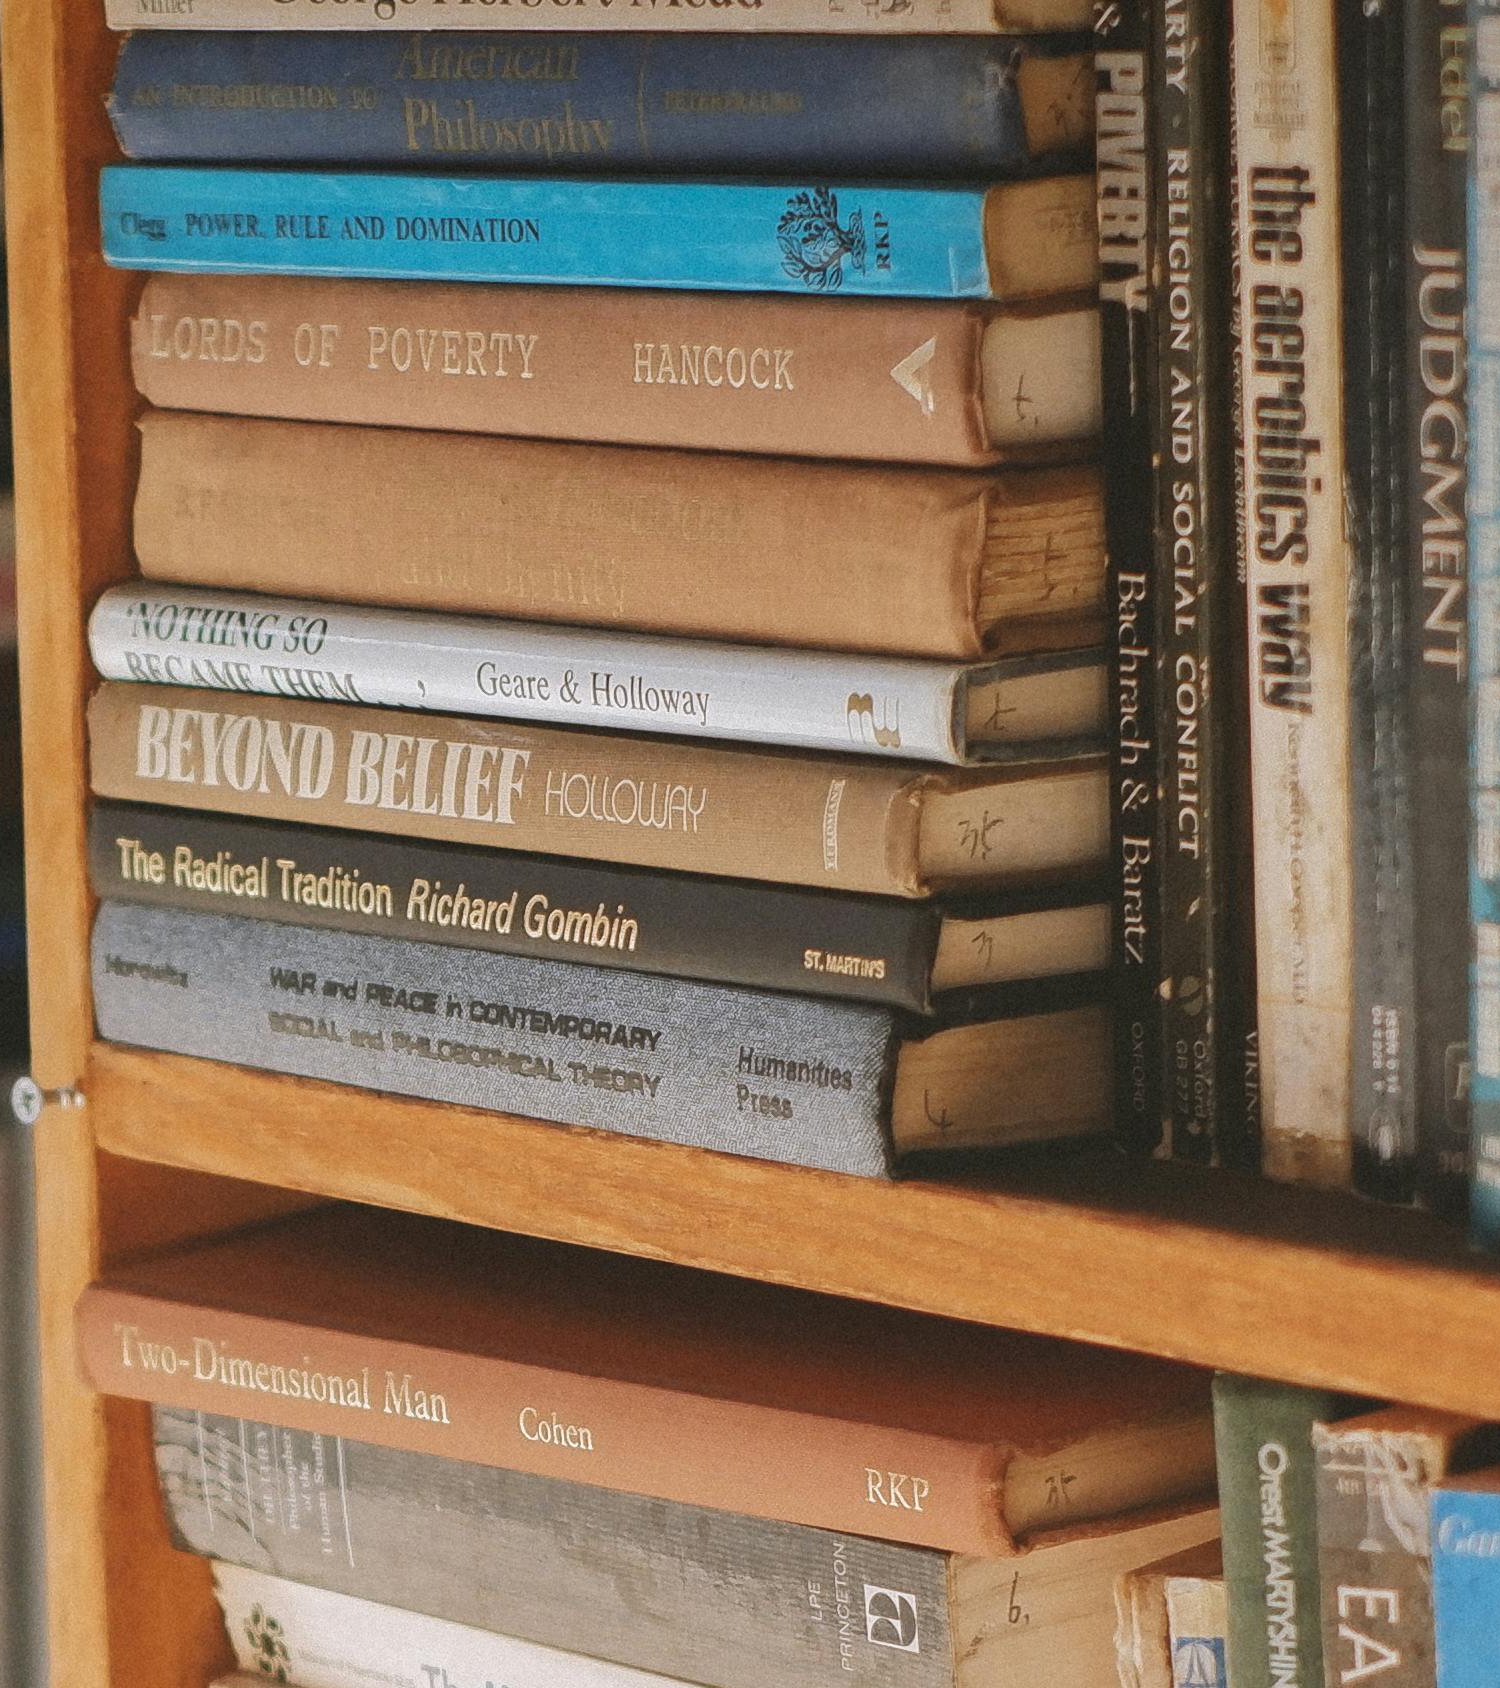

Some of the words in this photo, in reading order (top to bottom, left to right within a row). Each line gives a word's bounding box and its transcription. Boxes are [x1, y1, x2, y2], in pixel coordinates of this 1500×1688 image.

[399, 34, 579, 81] American
[403, 98, 615, 155] Philosophy
[274, 214, 329, 240] RULE
[341, 215, 386, 242] AND
[396, 216, 542, 243] DOMINATION
[1095, 51, 1148, 330] POVERTY
[1249, 166, 1317, 263] the
[874, 211, 891, 272] RKP
[1167, 149, 1193, 351] RELIGION
[148, 314, 268, 364] LORDS
[294, 323, 339, 367] OF
[367, 325, 540, 381] POVERTY
[633, 342, 795, 391] HANCOCK
[1170, 367, 1194, 465] AND
[1250, 285, 1322, 566] aerobics
[1413, 245, 1469, 682] JUDGMENT
[1172, 481, 1198, 634] SOCIAL
[282, 615, 329, 655] SO
[1117, 570, 1150, 765] Bachrach
[1258, 581, 1314, 714] way
[476, 661, 550, 702] Geare
[559, 669, 582, 706] &
[591, 671, 711, 727] Holloway
[136, 704, 334, 801] BEYOND
[344, 729, 531, 825] BELIEF
[1122, 778, 1150, 814] &
[1174, 653, 1199, 859] CONFLICT
[544, 768, 708, 834] HOLLOWAY
[117, 838, 166, 884] The
[174, 846, 269, 899] Radical
[276, 858, 393, 917] Tradition
[407, 877, 518, 934] Richard
[523, 893, 639, 952] Gombin
[1122, 835, 1152, 966] Baratz
[804, 949, 825, 971] ST.
[269, 965, 316, 998] WAR
[321, 978, 357, 1002] and
[365, 981, 439, 1016] PEACE
[445, 987, 464, 1017] in
[469, 998, 663, 1053] CONTEMPORARY
[267, 1009, 344, 1043] SOCIAL
[350, 1026, 385, 1052] and
[391, 1029, 563, 1084] PHILOSOPHICAL
[567, 1060, 663, 1098] THEORY
[737, 1044, 853, 1092] Humanities
[1131, 1021, 1146, 1115] OXFORD
[1245, 1031, 1258, 1140] VIKING
[736, 1084, 793, 1119] Press
[115, 1322, 370, 1410] Two-Dimensional
[383, 1371, 450, 1424] Man
[518, 1407, 594, 1451] Cohen
[864, 1467, 929, 1511] RKP
[1257, 1443, 1288, 1527] Orest
[807, 1580, 823, 1620] LPE
[831, 1541, 854, 1671] PRINCETON
